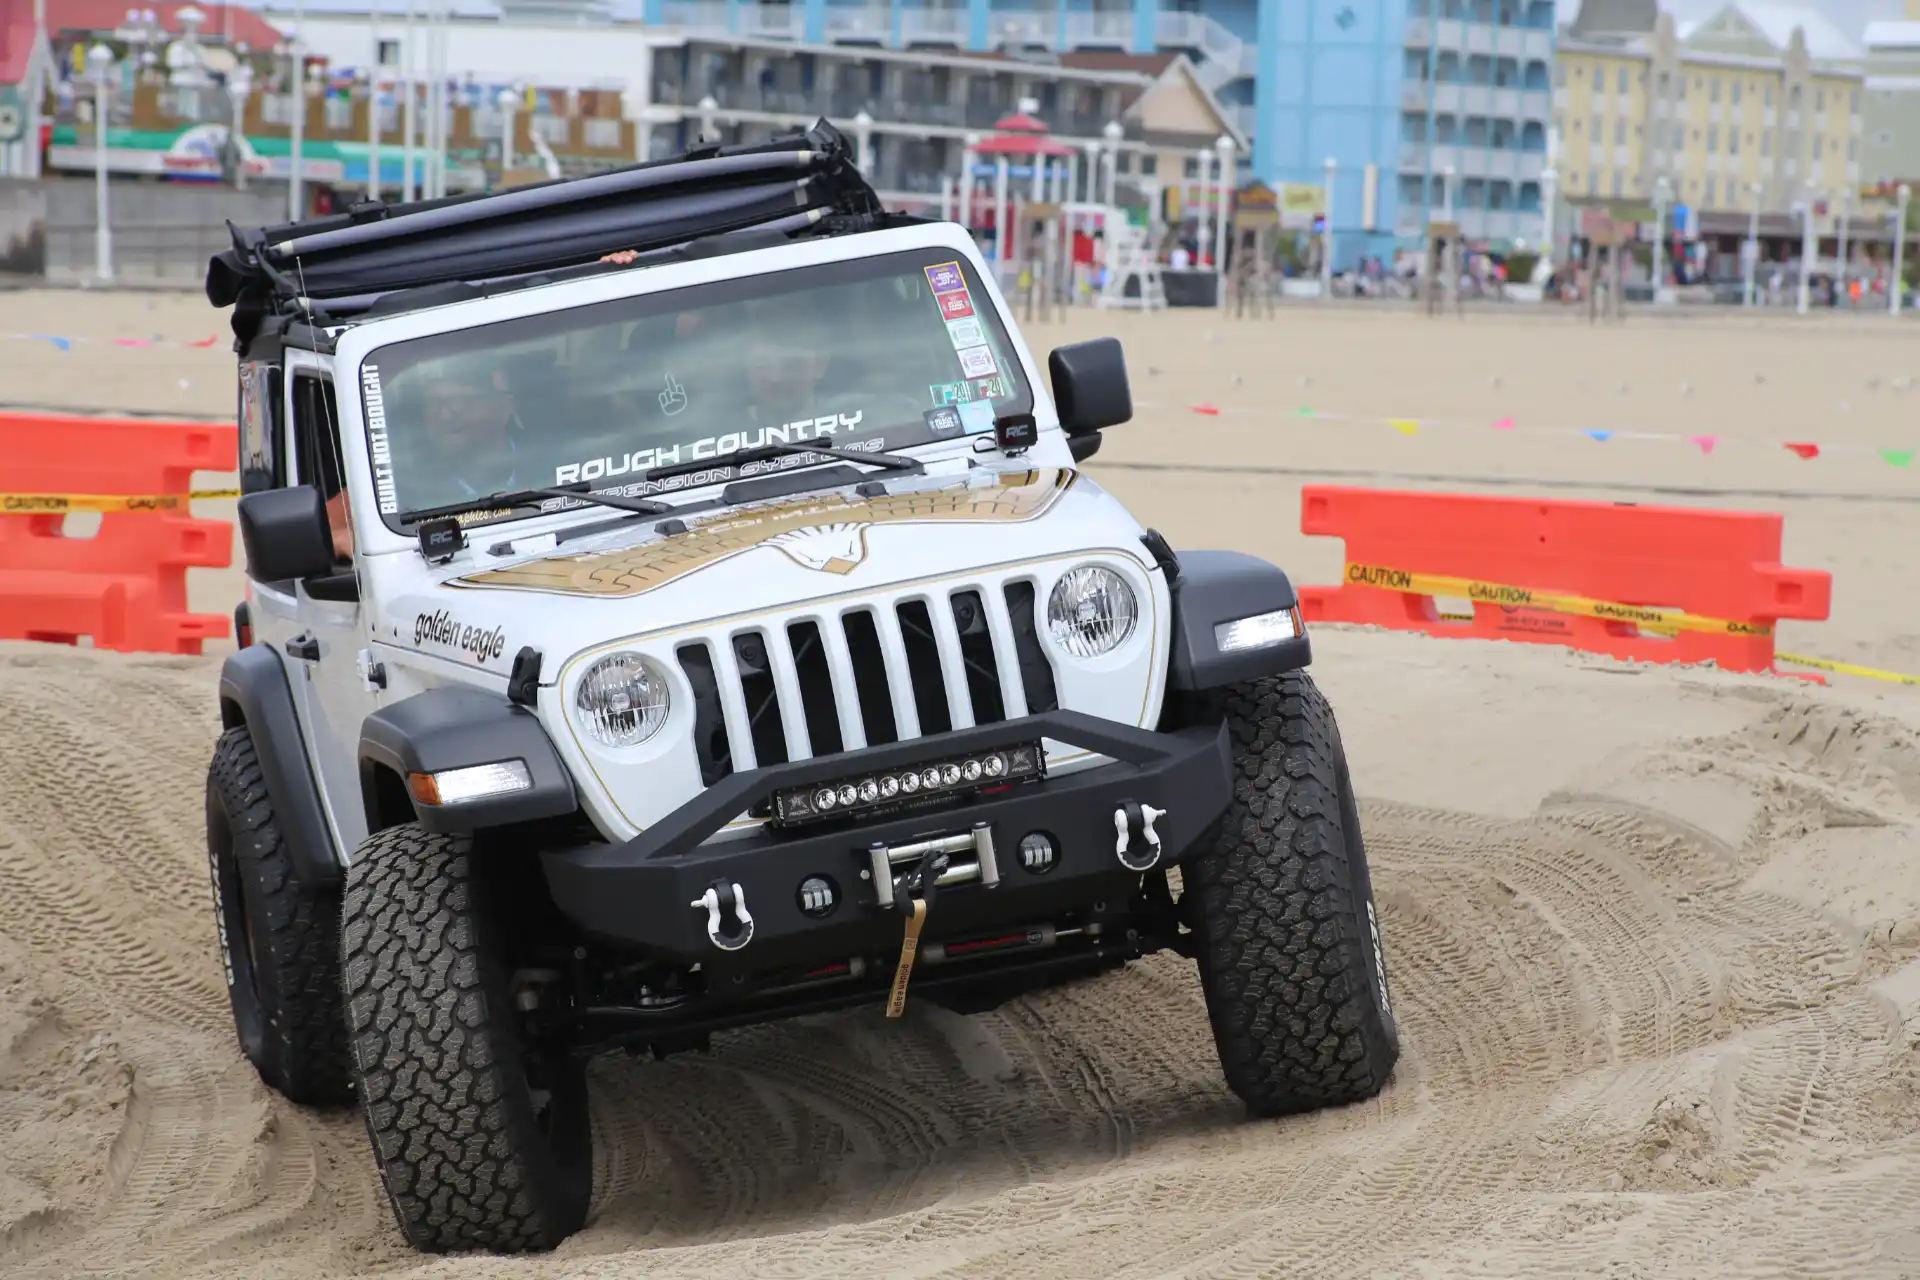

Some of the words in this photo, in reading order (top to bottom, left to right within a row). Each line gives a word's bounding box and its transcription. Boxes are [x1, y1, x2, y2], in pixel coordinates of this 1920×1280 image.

[362, 364, 386, 429] BOUGHT
[1005, 424, 1029, 438] RC
[371, 432, 391, 464] NOT
[556, 444, 680, 486] ROUGH
[692, 410, 862, 460] COUNTRY
[376, 468, 397, 514] BUILT
[430, 530, 453, 546] RC
[1349, 565, 1411, 588] CAUTION
[1469, 583, 1531, 604] CAUTION
[414, 609, 461, 647] golden
[462, 625, 505, 663] eagle
